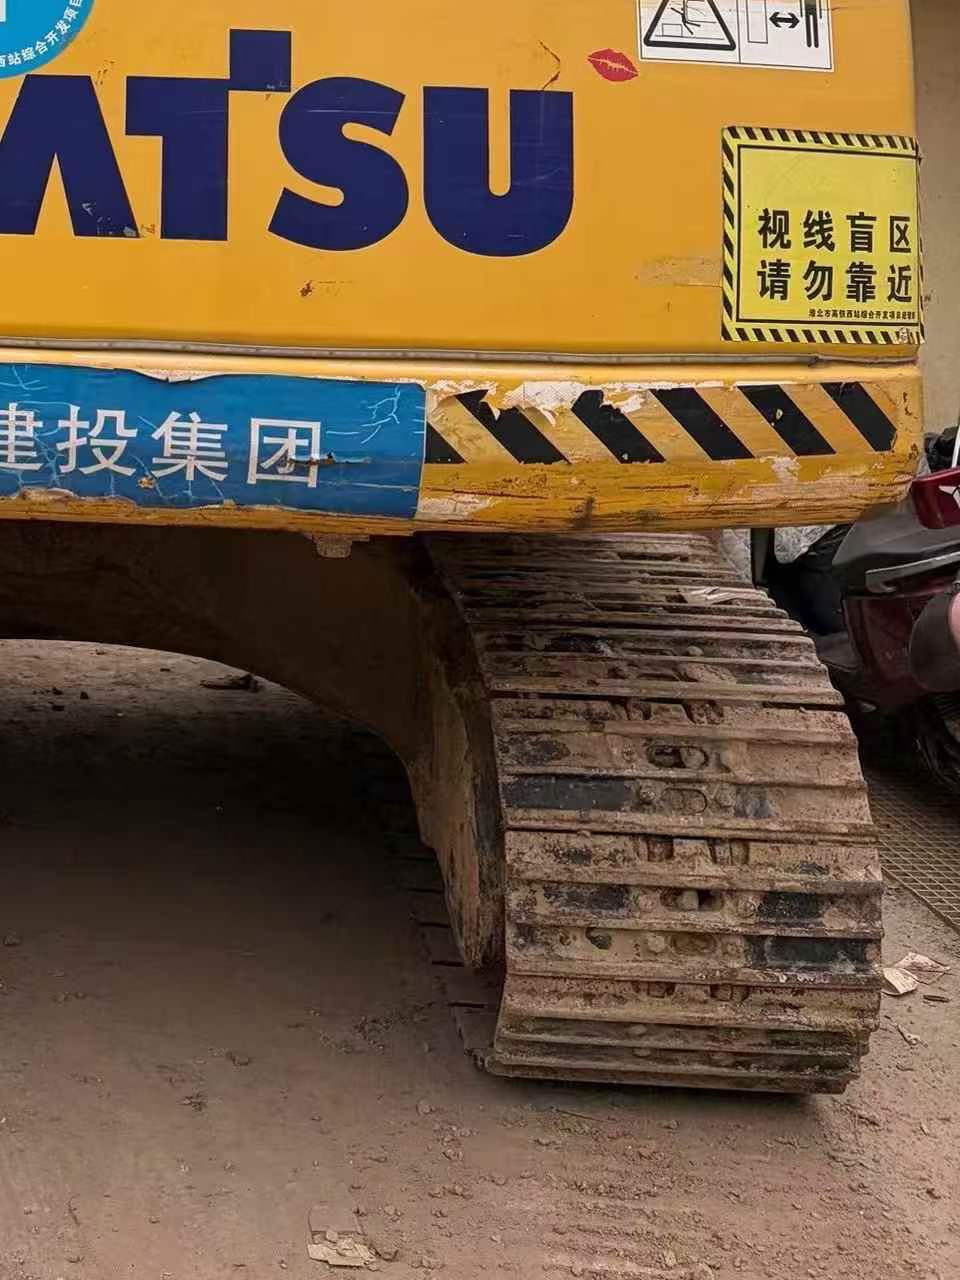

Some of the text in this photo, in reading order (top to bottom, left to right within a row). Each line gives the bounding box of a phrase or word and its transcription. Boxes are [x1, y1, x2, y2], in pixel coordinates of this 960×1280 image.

[757, 208, 912, 253] 视线盲区
[757, 259, 912, 303] 请勿靠近
